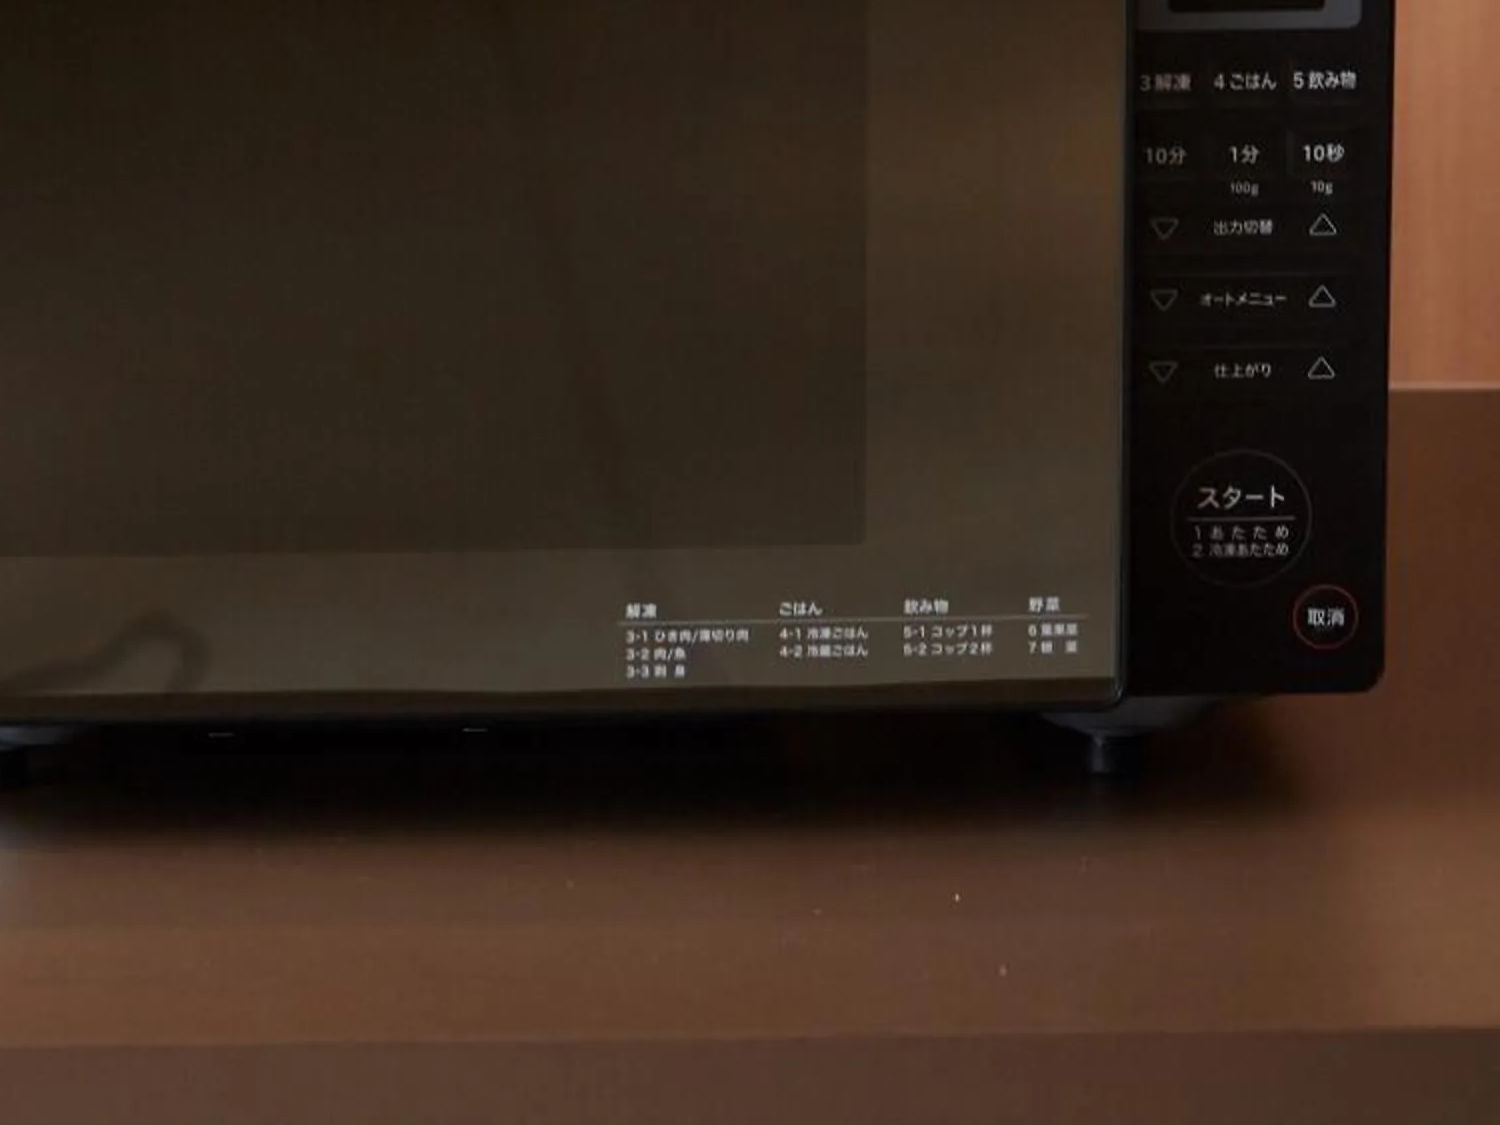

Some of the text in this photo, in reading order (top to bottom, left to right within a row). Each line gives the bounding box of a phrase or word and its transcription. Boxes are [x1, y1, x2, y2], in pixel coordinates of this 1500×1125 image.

[1214, 73, 1277, 90] 4 ごはん
[1293, 71, 1357, 90] 5 飲み物
[1146, 147, 1187, 165] 10分
[1230, 146, 1260, 164] 1分
[1303, 144, 1345, 163] 10秒
[1230, 183, 1259, 196] 100g
[1201, 292, 1287, 308] オートメニュー
[1197, 485, 1285, 510] スタート
[1307, 608, 1345, 626] 取消
